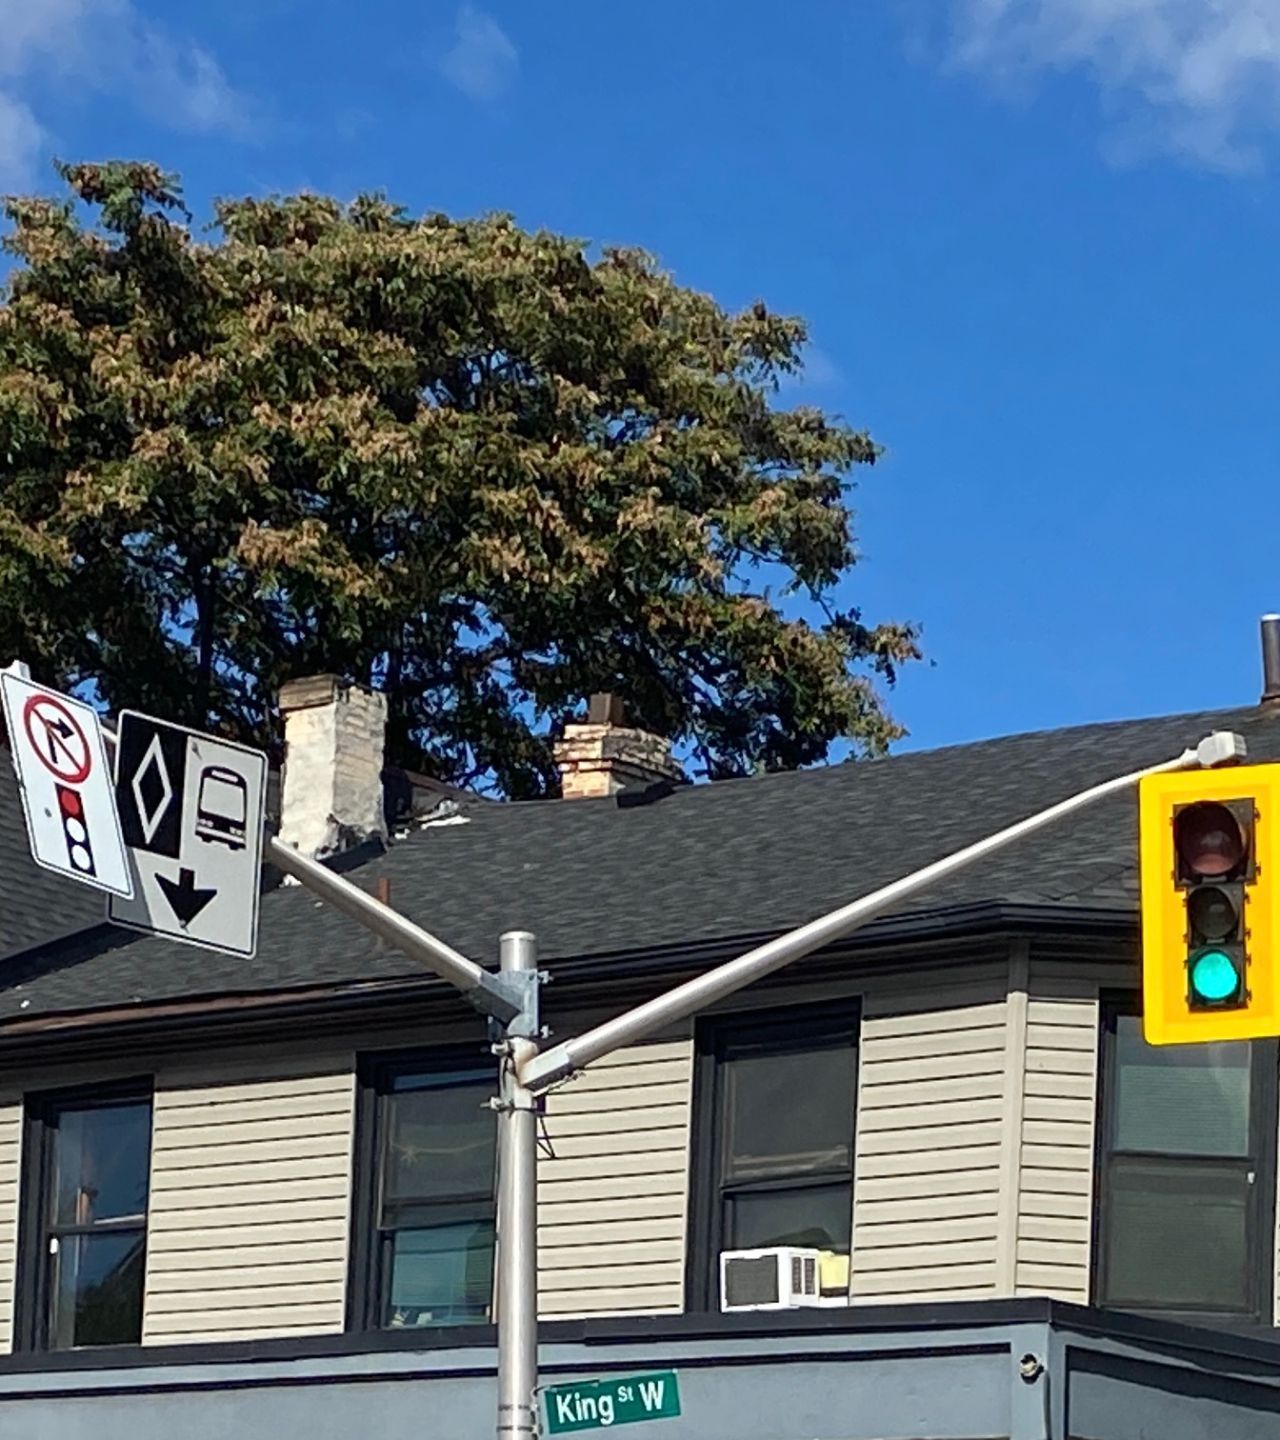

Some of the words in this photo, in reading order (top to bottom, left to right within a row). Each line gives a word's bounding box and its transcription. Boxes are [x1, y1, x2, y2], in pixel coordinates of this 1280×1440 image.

[556, 1392, 614, 1425] King
[617, 1385, 634, 1402] St
[638, 1380, 664, 1411] W
